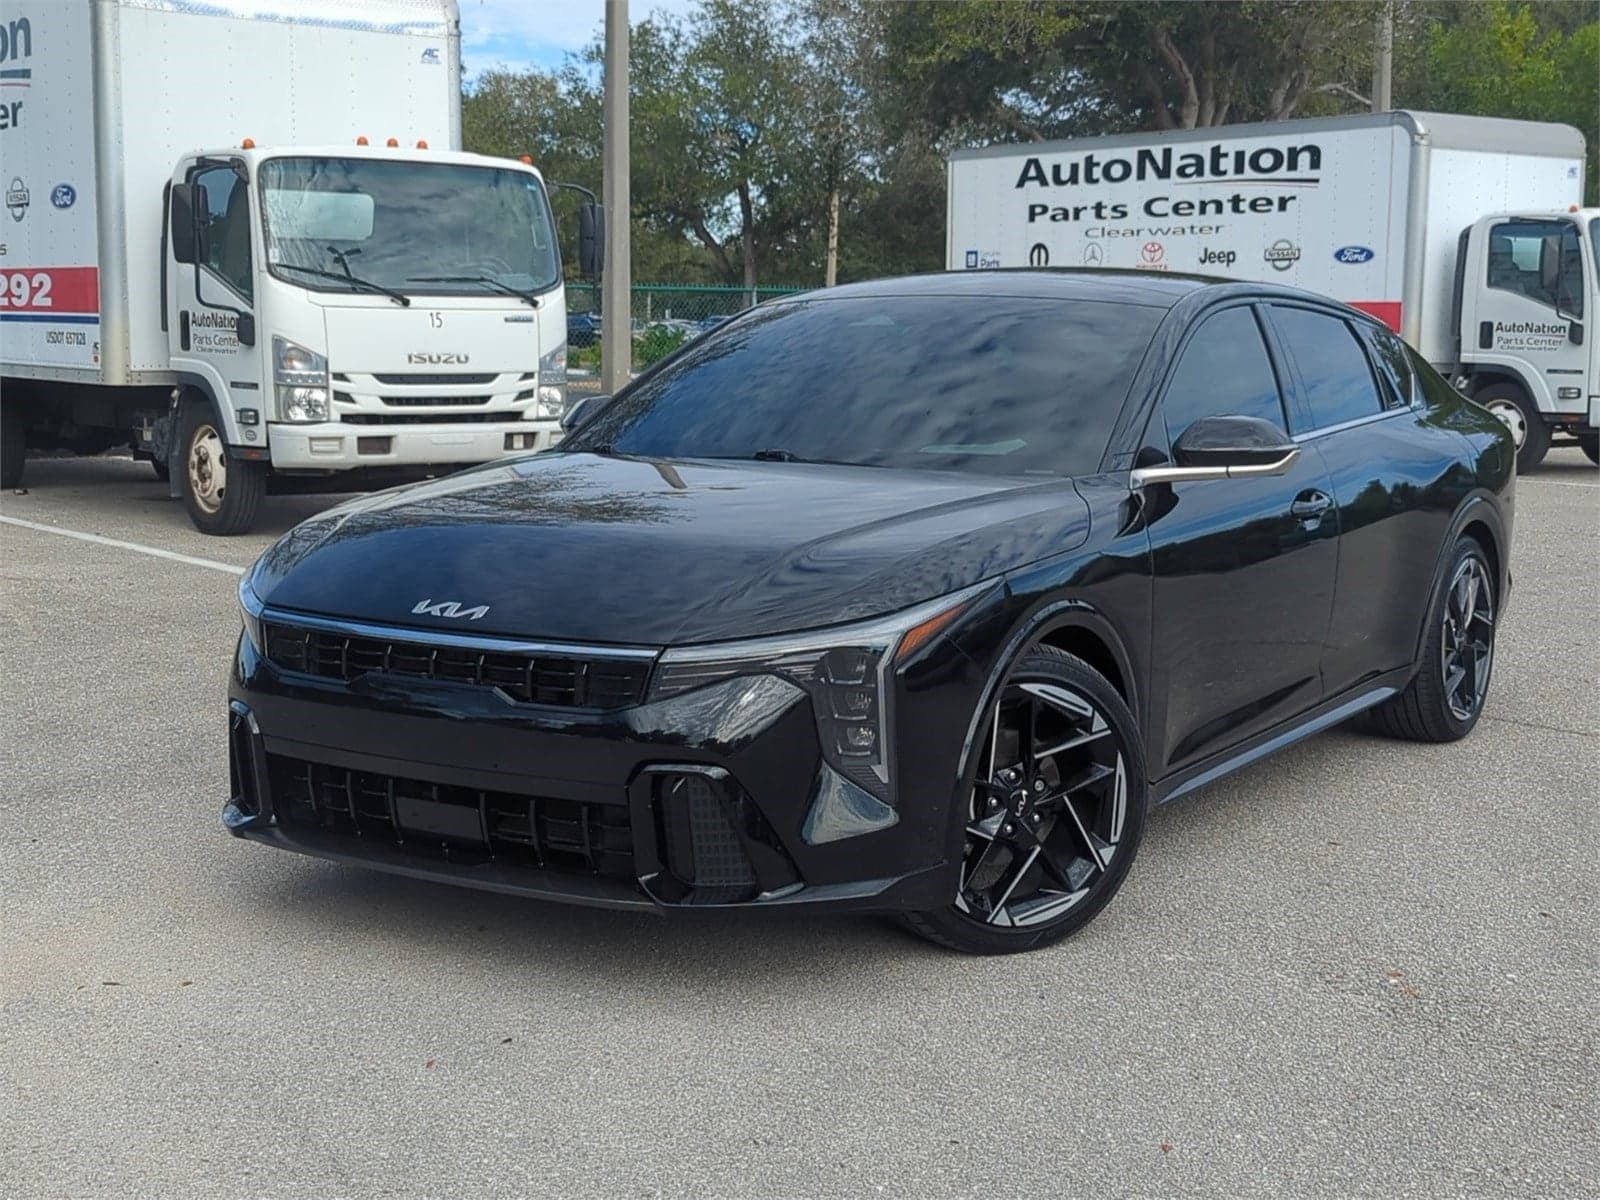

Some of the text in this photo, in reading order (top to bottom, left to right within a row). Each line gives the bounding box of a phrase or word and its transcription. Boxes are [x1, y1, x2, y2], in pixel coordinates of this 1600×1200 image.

[1015, 143, 1323, 189] AutoNation
[1028, 192, 1297, 224] Parts Center
[1084, 223, 1226, 239] Clearwater
[1199, 248, 1236, 267] Jeep
[1267, 250, 1298, 258] NISSAN
[1340, 248, 1368, 262] Ford
[430, 312, 443, 328] 15
[1495, 321, 1567, 334] AutoNation
[193, 333, 212, 346] Parts
[1497, 336, 1563, 347] Parts Center
[407, 353, 470, 364] ISUZU
[411, 599, 490, 620] KIA
